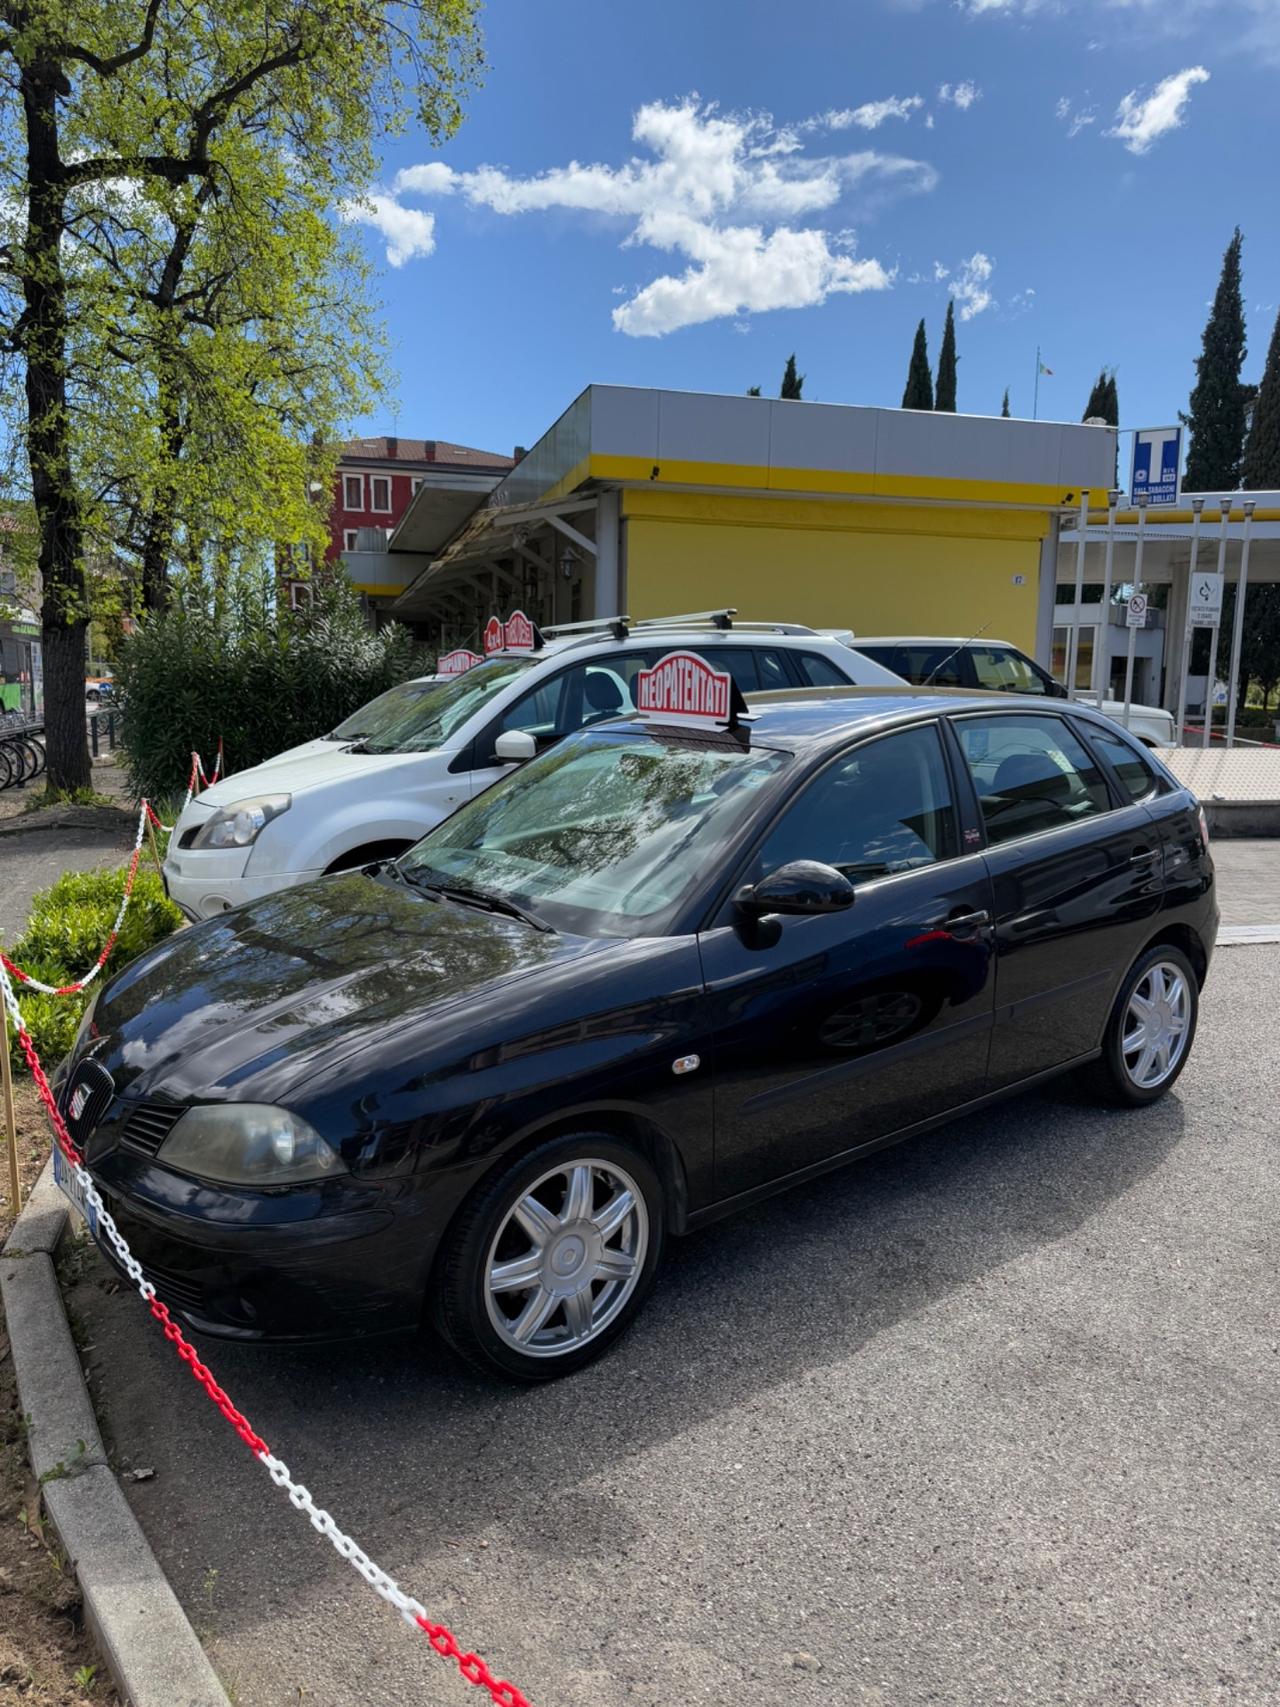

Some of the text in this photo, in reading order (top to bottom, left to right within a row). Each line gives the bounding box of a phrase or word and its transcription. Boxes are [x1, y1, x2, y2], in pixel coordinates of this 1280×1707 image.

[1139, 430, 1177, 483] T
[1148, 484, 1175, 493] TABACCHI
[641, 658, 726, 714] NEOPATENTATI
